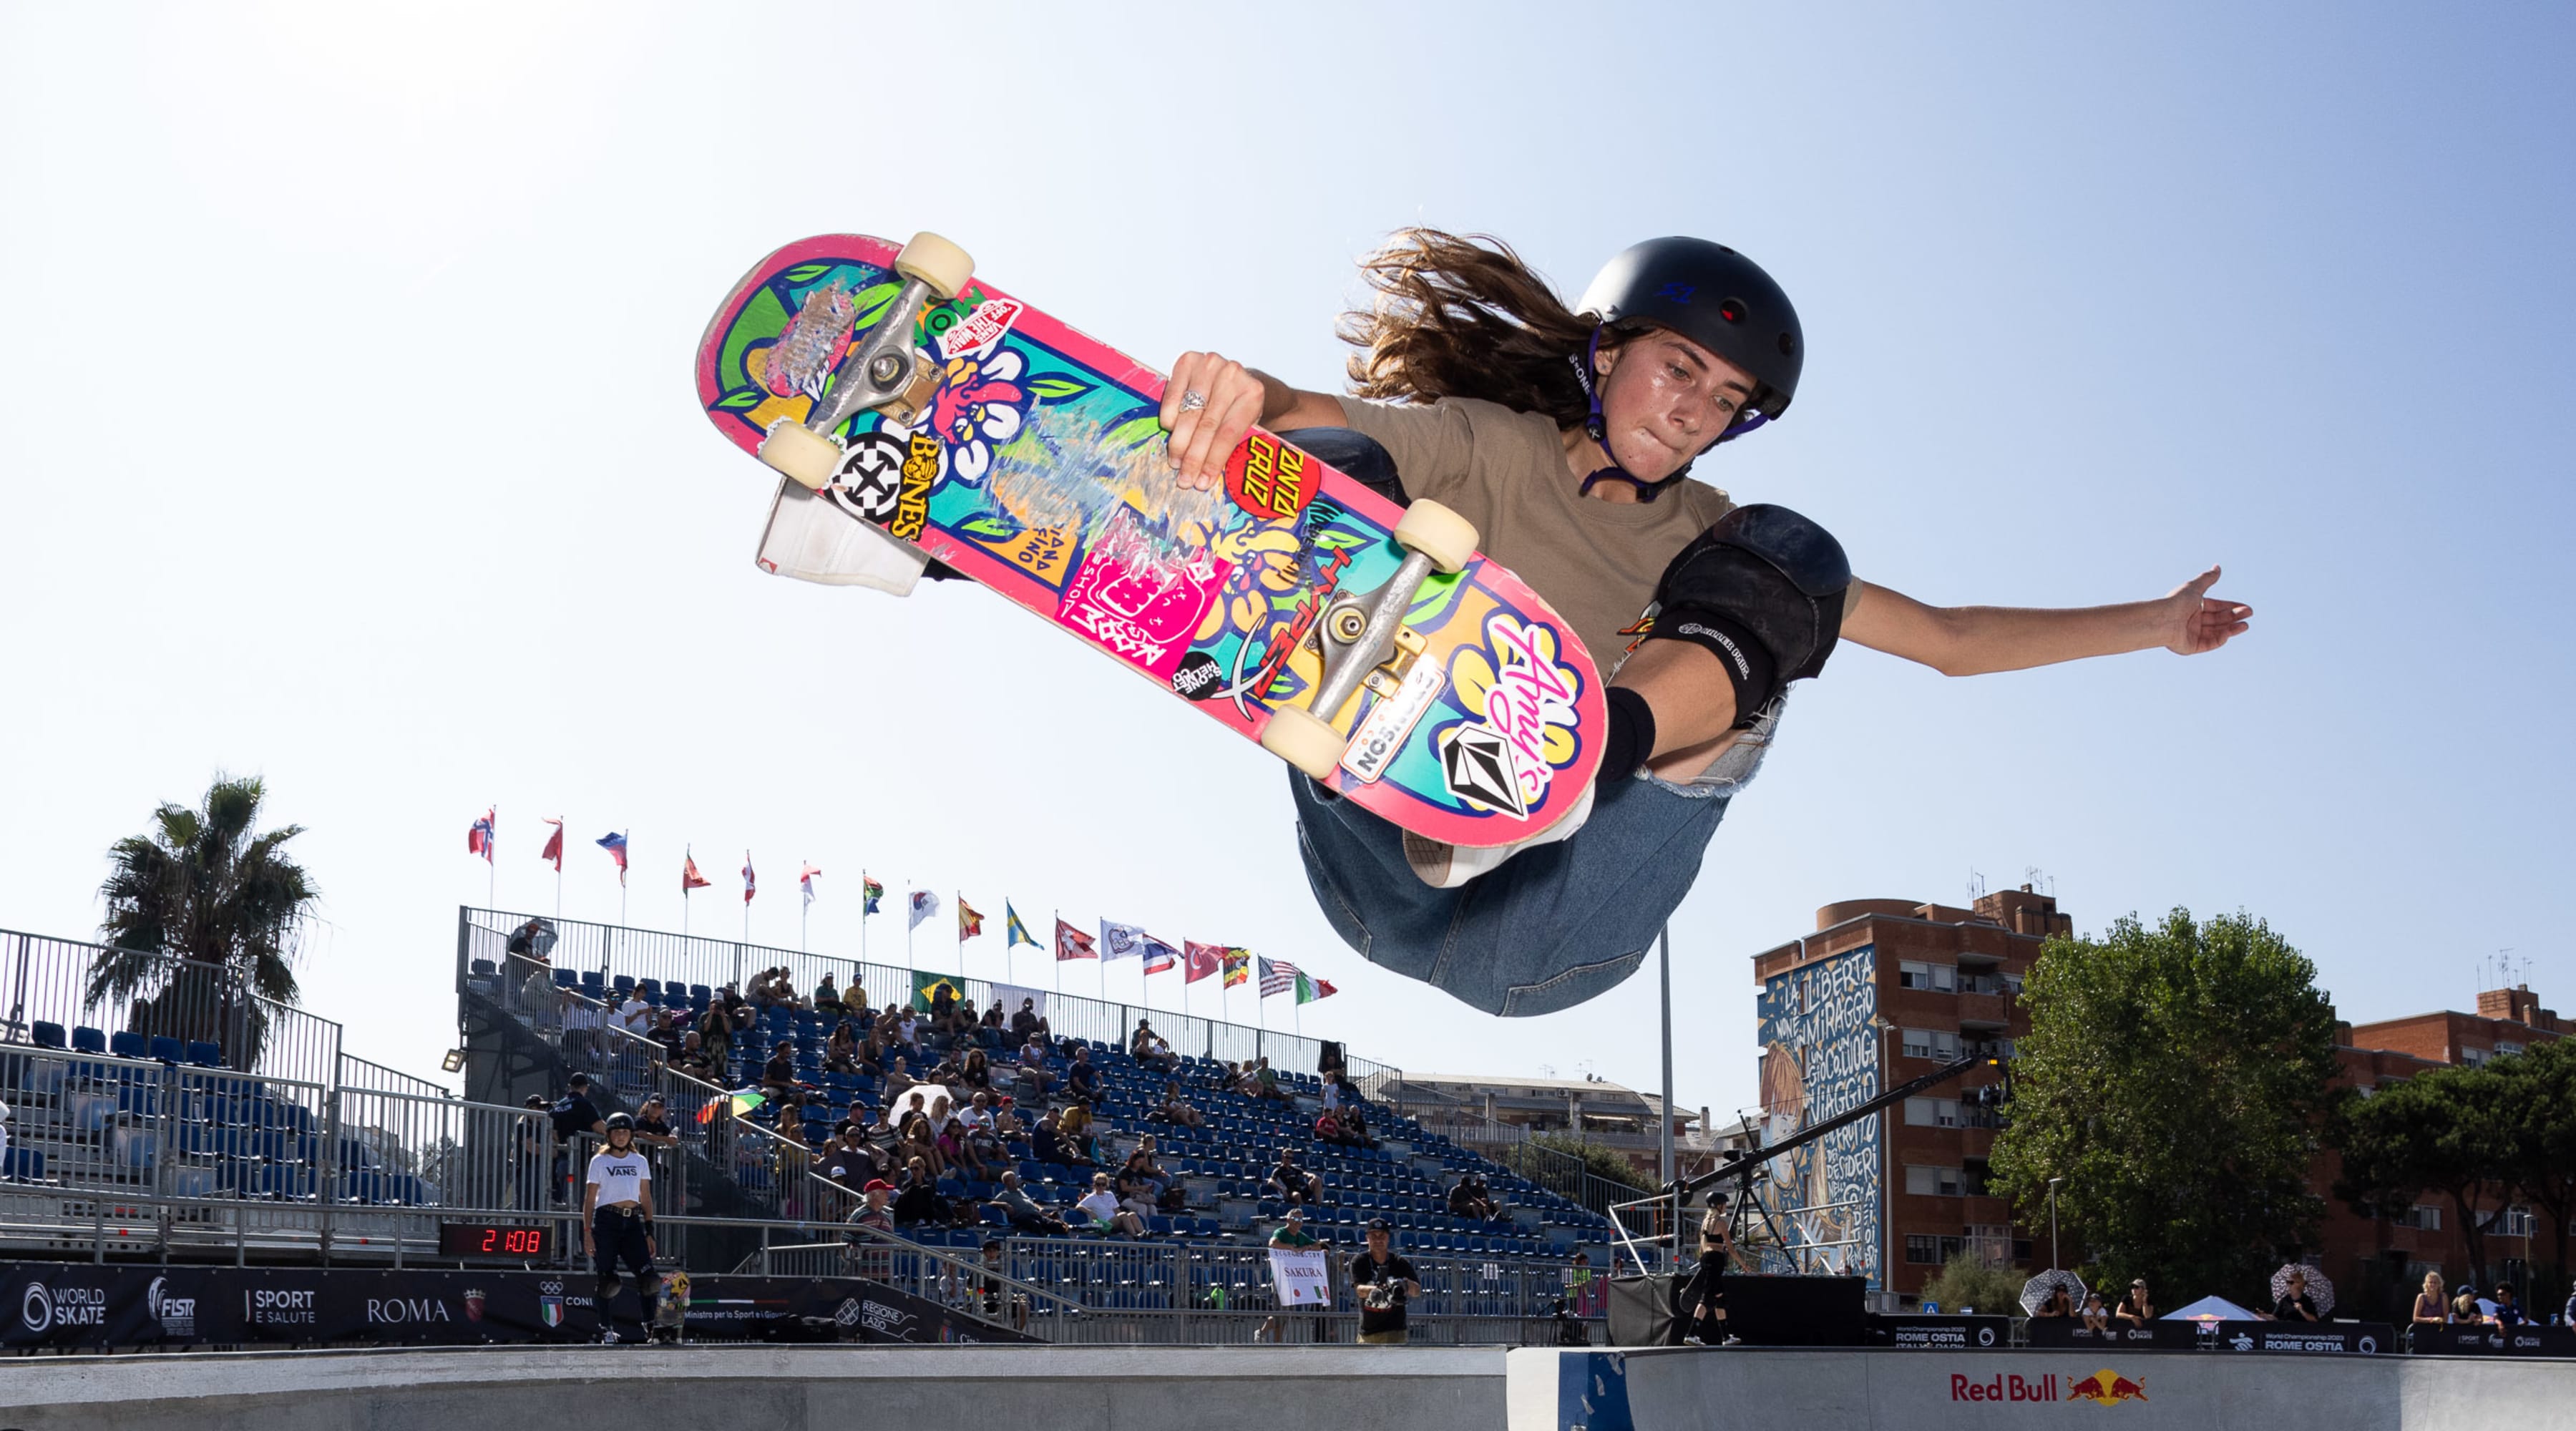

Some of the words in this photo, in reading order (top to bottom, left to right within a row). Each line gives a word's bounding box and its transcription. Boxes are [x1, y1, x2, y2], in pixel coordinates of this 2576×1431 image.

[968, 315, 992, 335] THE
[973, 320, 1005, 346] VANS
[1242, 435, 1275, 507] CRUZ
[892, 434, 940, 542] BONES
[1272, 445, 1305, 519] SANTA
[1171, 668, 1191, 683] CO
[1172, 660, 1218, 692] HELMET
[1491, 622, 1571, 792] Amy's
[1785, 983, 1800, 1011] LA
[606, 1165, 638, 1177] VANS
[1284, 1266, 1323, 1278] SAKURA
[53, 1288, 105, 1306] WORLD
[255, 1290, 315, 1309] SPORT
[565, 1297, 592, 1307] CONI
[56, 1306, 107, 1326] SKATE
[255, 1312, 263, 1324] E
[266, 1311, 316, 1324] SALUTE
[368, 1299, 450, 1323] ROMA
[685, 1310, 713, 1319] Ministro
[714, 1312, 724, 1321] per
[734, 1310, 754, 1321] Sport
[863, 1301, 899, 1322] REGIONE
[862, 1314, 887, 1330] LAZIO
[1896, 1332, 1929, 1342] ROME
[1931, 1332, 1966, 1342] OSTIA
[2265, 1340, 2303, 1350] ROME
[2304, 1341, 2343, 1352] OSTIA
[2285, 1333, 2326, 1342] Championship
[1951, 1373, 2003, 1402] Red
[2008, 1373, 2058, 1402] Bull
